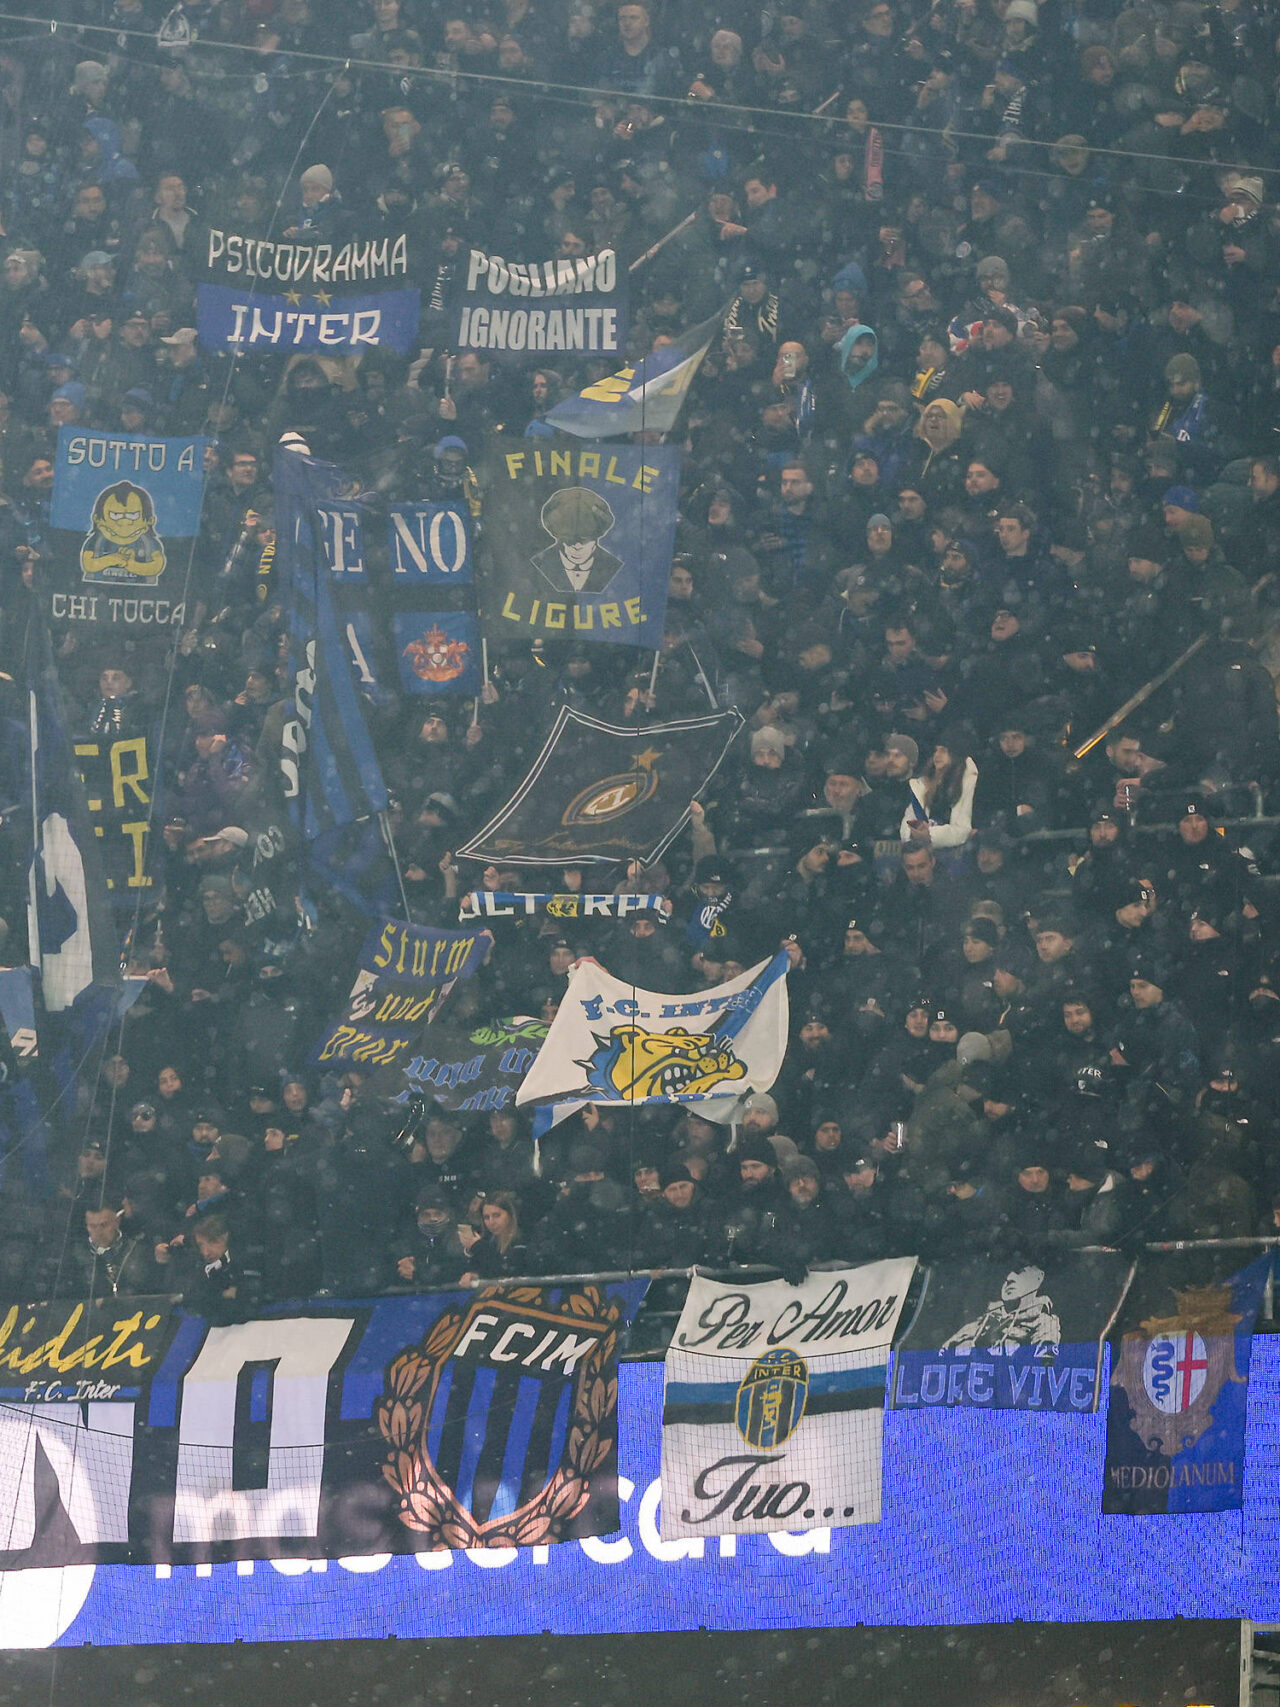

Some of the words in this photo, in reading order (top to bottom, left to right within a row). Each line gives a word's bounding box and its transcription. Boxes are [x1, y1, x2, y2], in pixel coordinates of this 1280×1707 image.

[208, 229, 408, 283] PSICODRAMMA
[466, 248, 617, 299] POGLIANO
[227, 304, 381, 346] INTER
[458, 306, 618, 351] IGNORANTE
[67, 437, 166, 471] SOTTO
[177, 444, 195, 472] A
[505, 450, 660, 494] FINALE
[52, 593, 98, 620] CHI
[108, 598, 186, 625] TOCCA
[501, 592, 648, 630] LIGURE
[372, 922, 476, 978] Sturm
[375, 988, 437, 1022] und
[679, 1293, 765, 1350] Per
[766, 1280, 899, 1346] Amor
[453, 1315, 599, 1377] FCIM
[66, 1378, 122, 1401] Inter
[753, 1364, 803, 1380] INTER
[1007, 1366, 1096, 1408] VIVE
[680, 1453, 856, 1525] Tuo...
[1110, 1461, 1235, 1491] MEDIOLANUM
